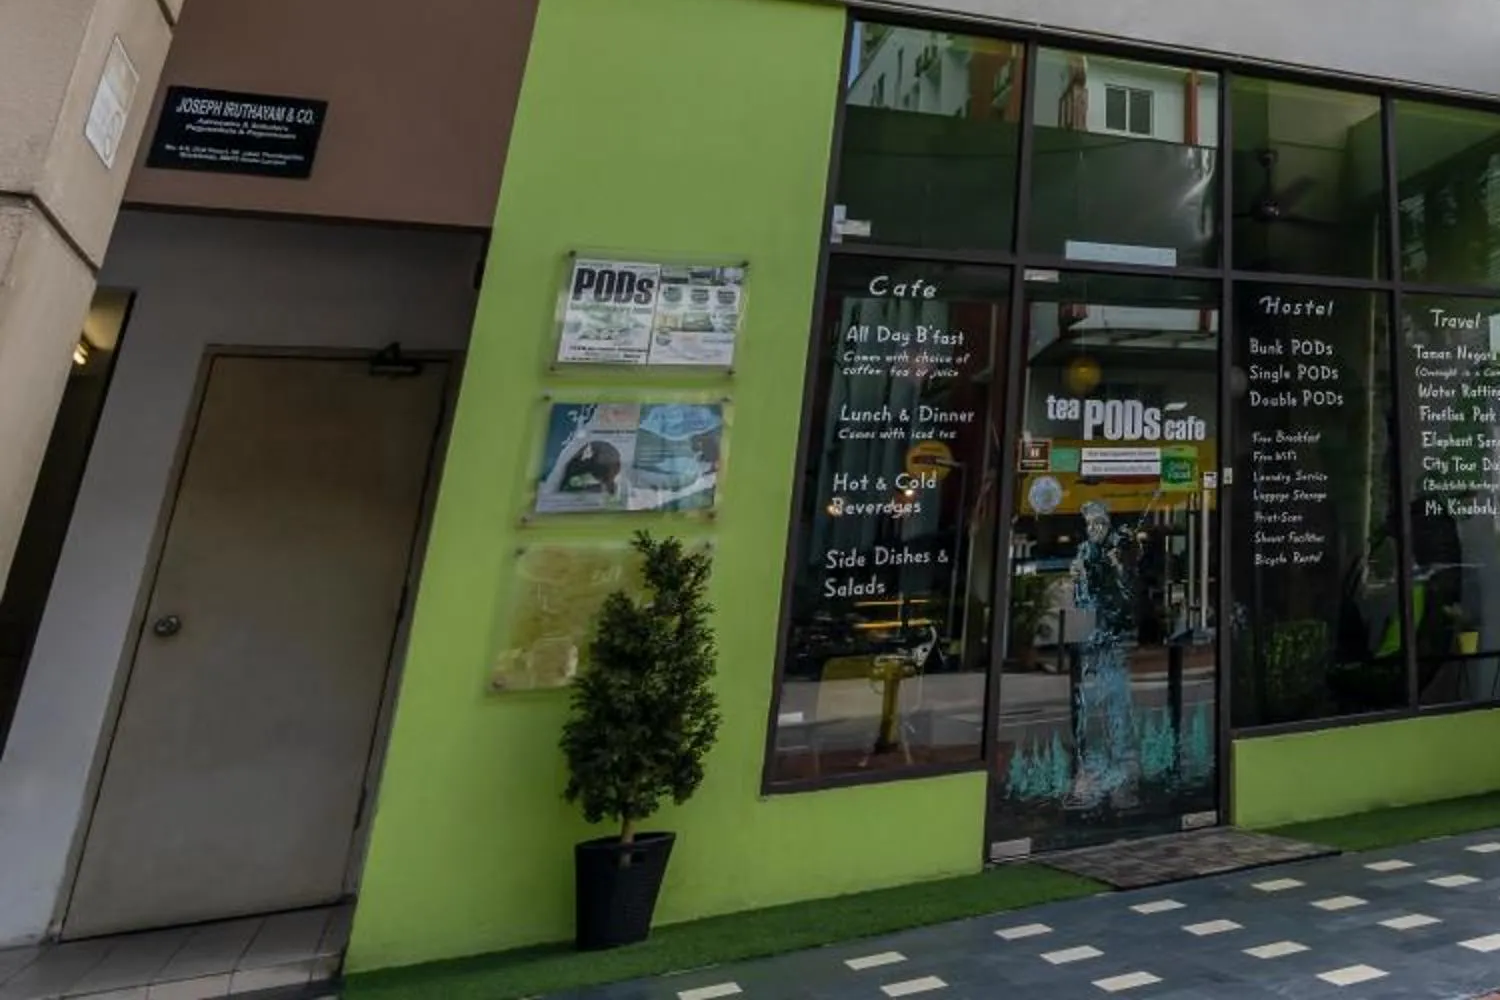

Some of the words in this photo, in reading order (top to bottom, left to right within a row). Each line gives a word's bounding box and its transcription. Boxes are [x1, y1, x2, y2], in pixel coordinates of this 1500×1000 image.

[176, 97, 223, 116] JOSEPH
[572, 267, 655, 305] PODs
[869, 275, 938, 299] Cafe
[1259, 295, 1334, 317] Hostel
[1430, 309, 1481, 330] Travel
[846, 325, 870, 342] All
[877, 325, 911, 347] Day
[916, 324, 964, 345] B'fast
[1249, 337, 1283, 355] Bunk
[1291, 338, 1334, 356] PODs
[1249, 363, 1291, 384] Single
[1297, 363, 1339, 381] PODs
[1249, 390, 1297, 407] Double
[1302, 389, 1344, 407] PODs
[841, 403, 892, 422] Lunch
[899, 408, 911, 422] &
[919, 404, 975, 423] Dinner
[1047, 394, 1080, 420] tea
[1083, 399, 1162, 441] PODs
[1164, 415, 1206, 441] cafe
[832, 471, 870, 492] Hot
[875, 476, 888, 491] &
[895, 470, 937, 490] Cold
[831, 497, 922, 519] Beverages
[826, 547, 867, 570] Side
[874, 546, 931, 567] Dishes
[937, 549, 949, 564] &
[824, 573, 886, 598] Salads
